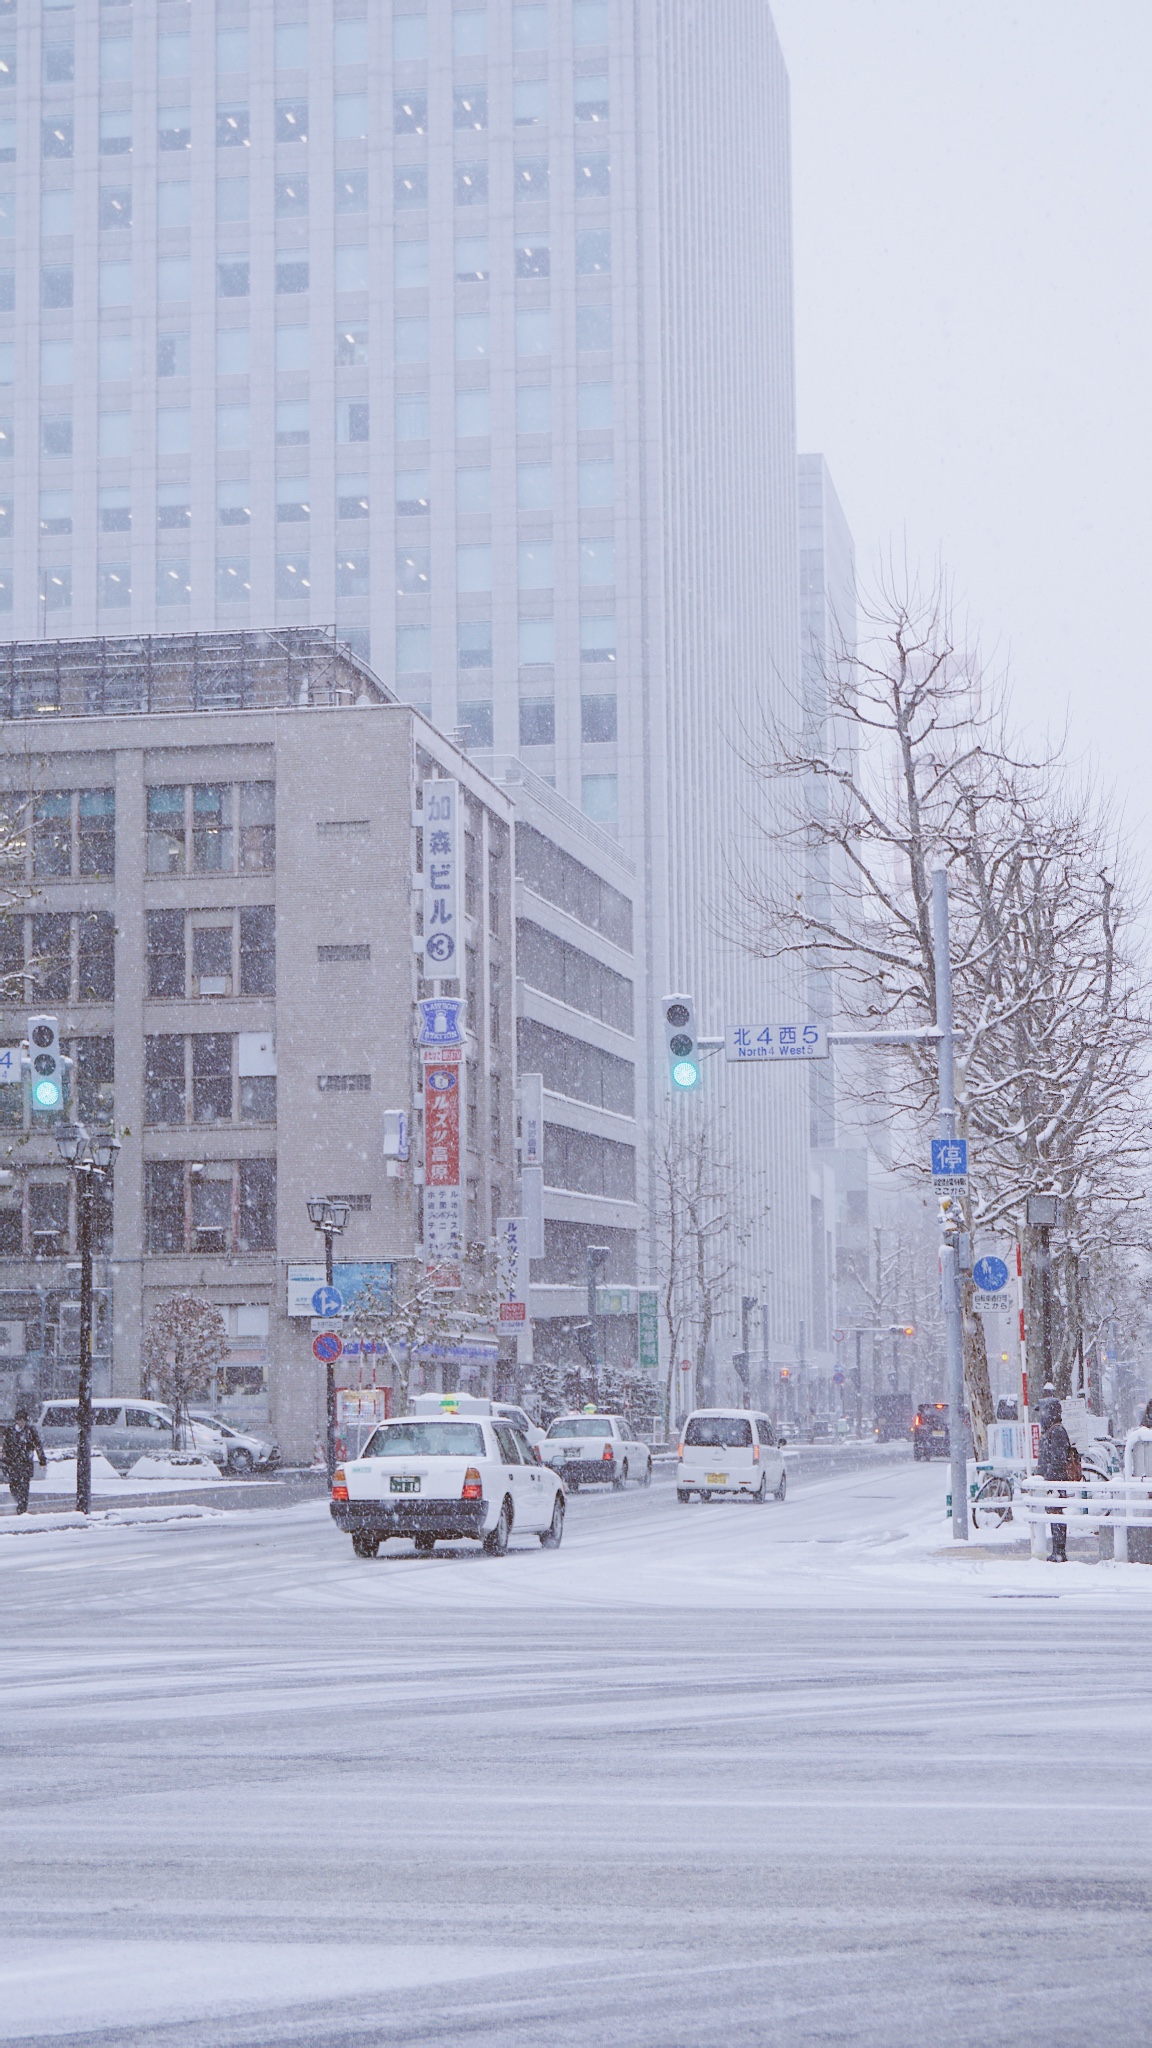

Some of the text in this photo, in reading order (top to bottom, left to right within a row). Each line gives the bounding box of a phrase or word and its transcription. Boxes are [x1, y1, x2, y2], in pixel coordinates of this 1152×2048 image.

[424, 1002, 457, 1010] LAWSON
[424, 1030, 457, 1039] STATION
[2, 1070, 8, 1079] 4
[430, 1094, 449, 1178] ルスツ高原
[937, 1145, 963, 1169] 停
[427, 1191, 458, 1199] ホテル
[934, 1187, 966, 1195] ここから
[427, 1222, 457, 1230] テニス
[975, 1302, 1007, 1310] ここから
